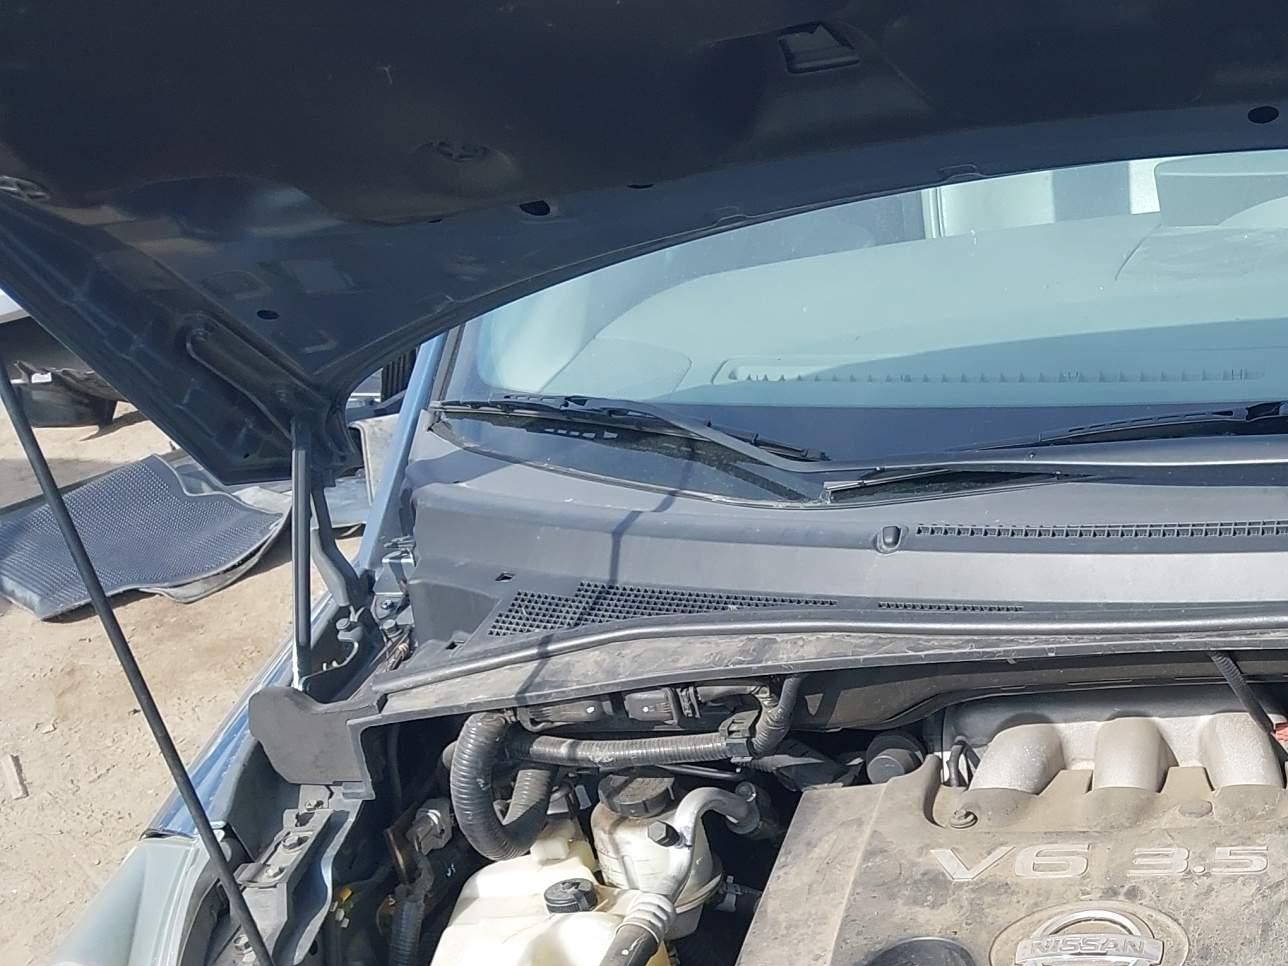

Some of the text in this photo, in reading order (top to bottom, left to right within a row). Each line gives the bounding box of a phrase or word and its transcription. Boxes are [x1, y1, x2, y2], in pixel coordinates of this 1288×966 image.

[930, 843, 1268, 881] V6 3.5
[1030, 935, 1146, 954] NISSAN
